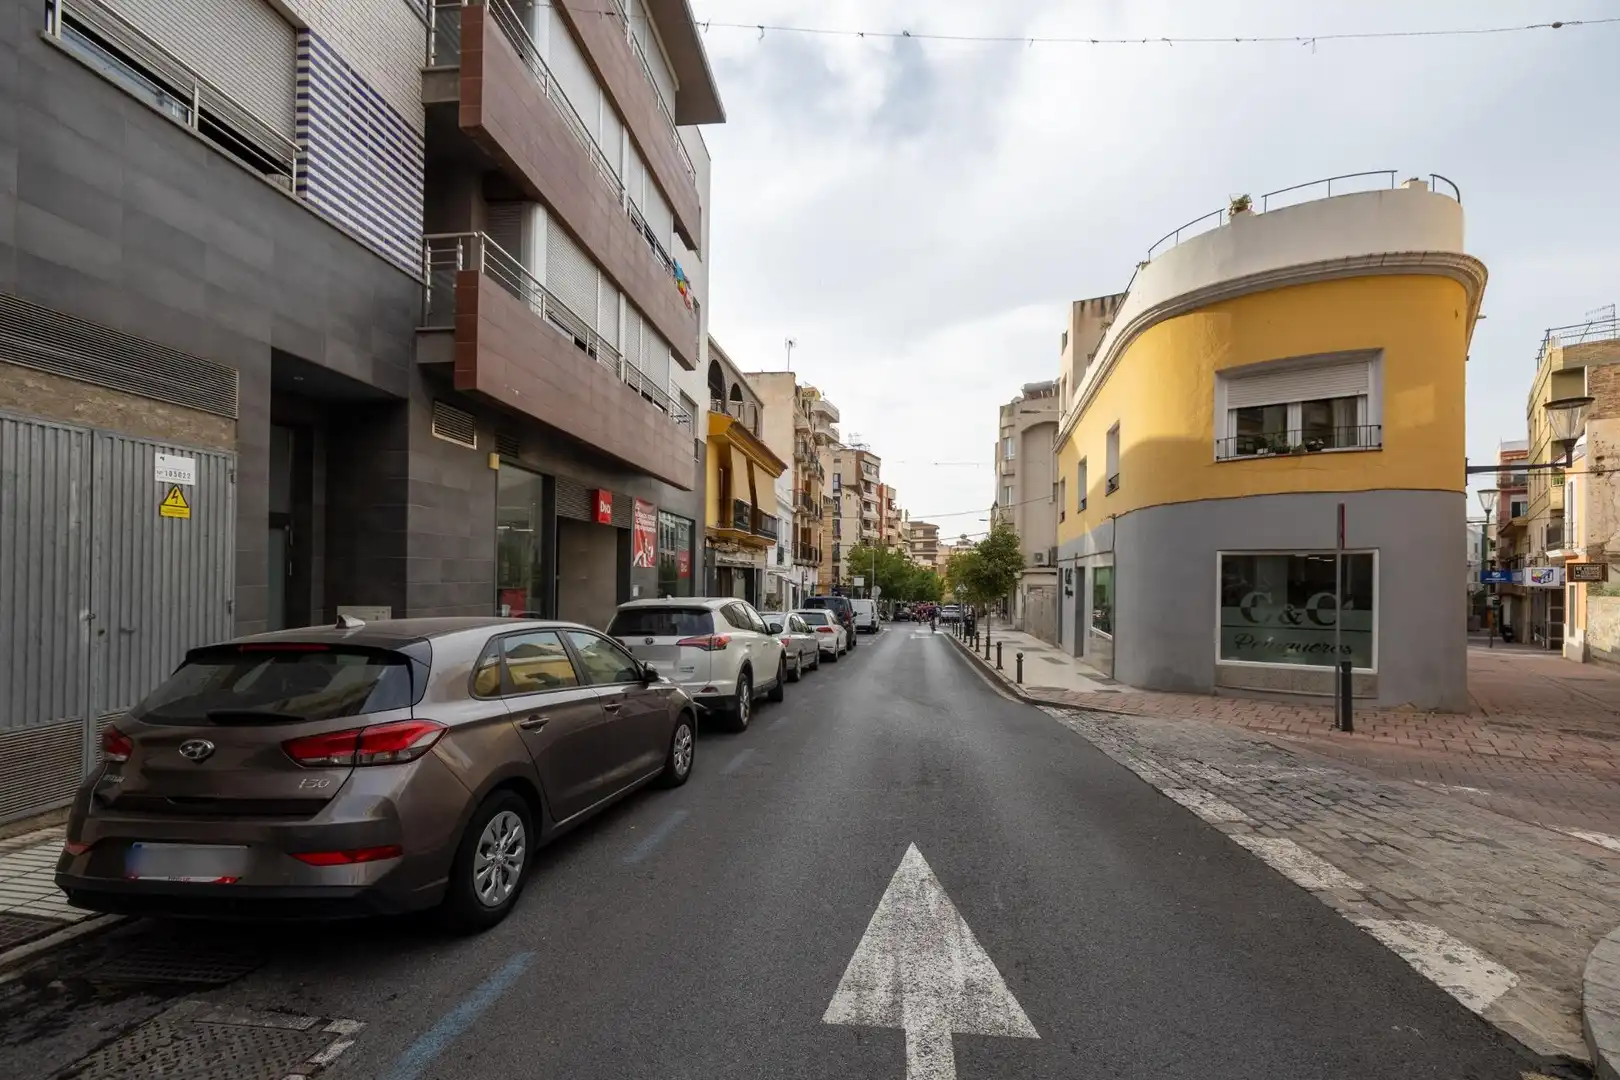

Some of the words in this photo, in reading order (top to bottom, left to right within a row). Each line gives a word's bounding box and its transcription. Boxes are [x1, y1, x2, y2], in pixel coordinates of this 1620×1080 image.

[1240, 592, 1272, 624] C
[1278, 604, 1303, 625] &
[1306, 592, 1341, 626] C
[1234, 632, 1352, 657] Pequeros
